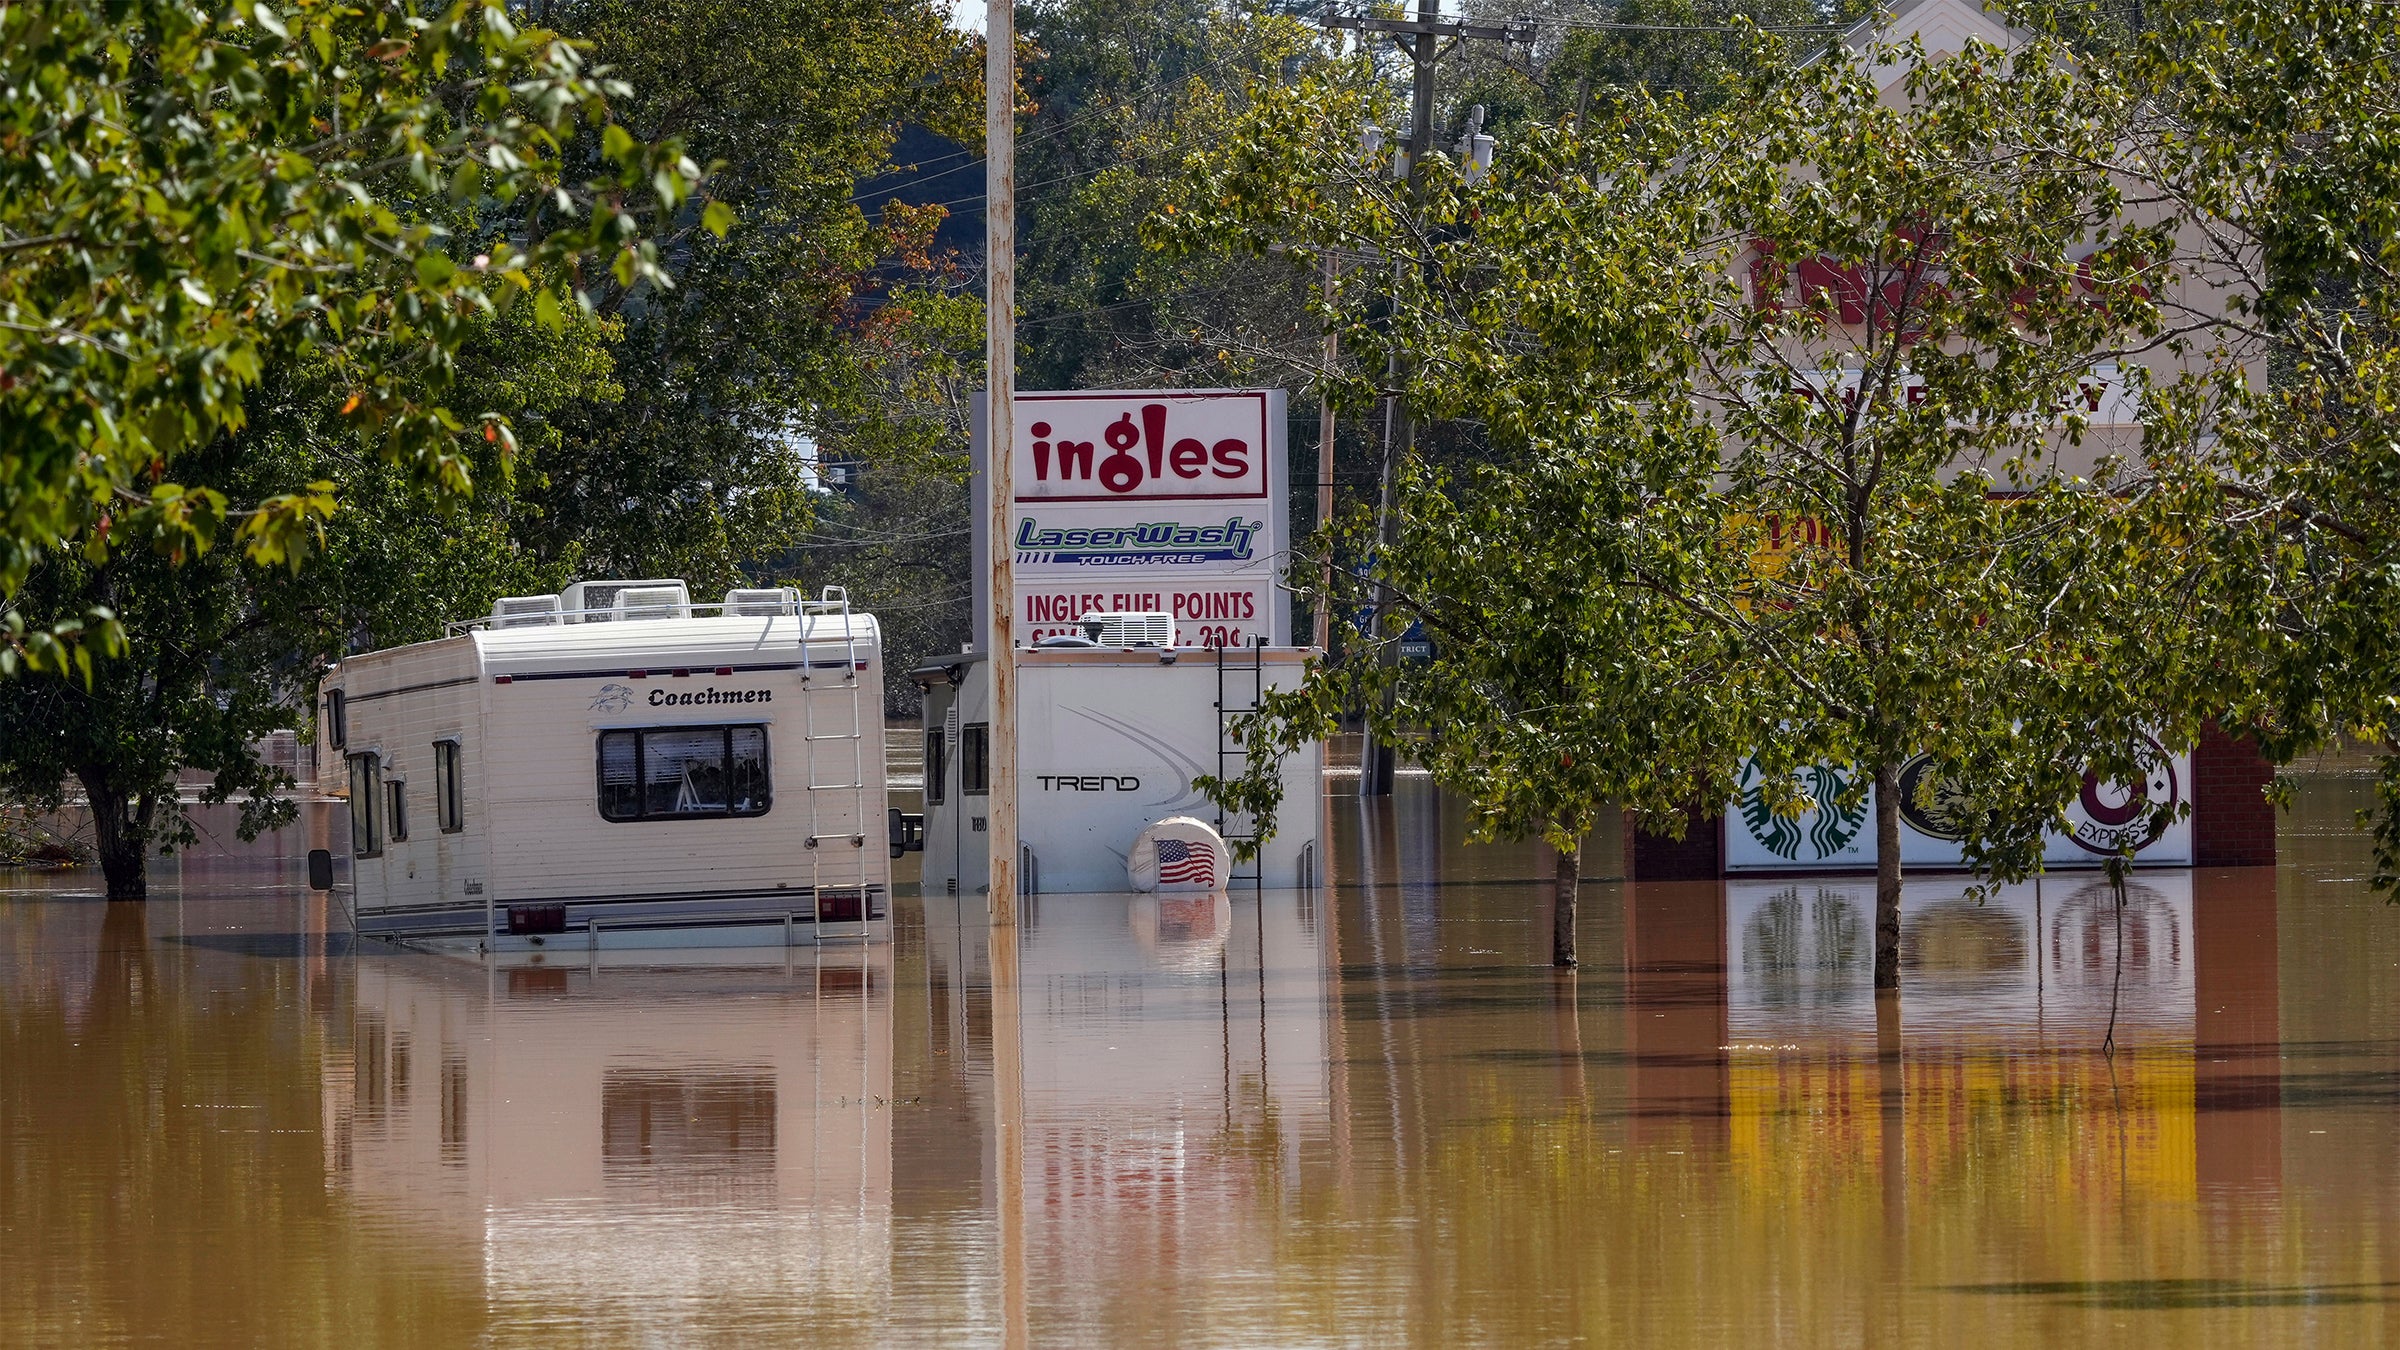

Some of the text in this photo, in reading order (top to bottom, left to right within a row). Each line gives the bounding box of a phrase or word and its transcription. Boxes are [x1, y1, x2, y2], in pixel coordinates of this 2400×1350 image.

[1030, 403, 1250, 493] ingles
[1027, 594, 1105, 622] INGLES
[1172, 591, 1254, 619] POINTS
[1401, 645, 1427, 653] TRICT
[648, 687, 772, 707] Coachmen
[1036, 775, 1140, 791] TREND
